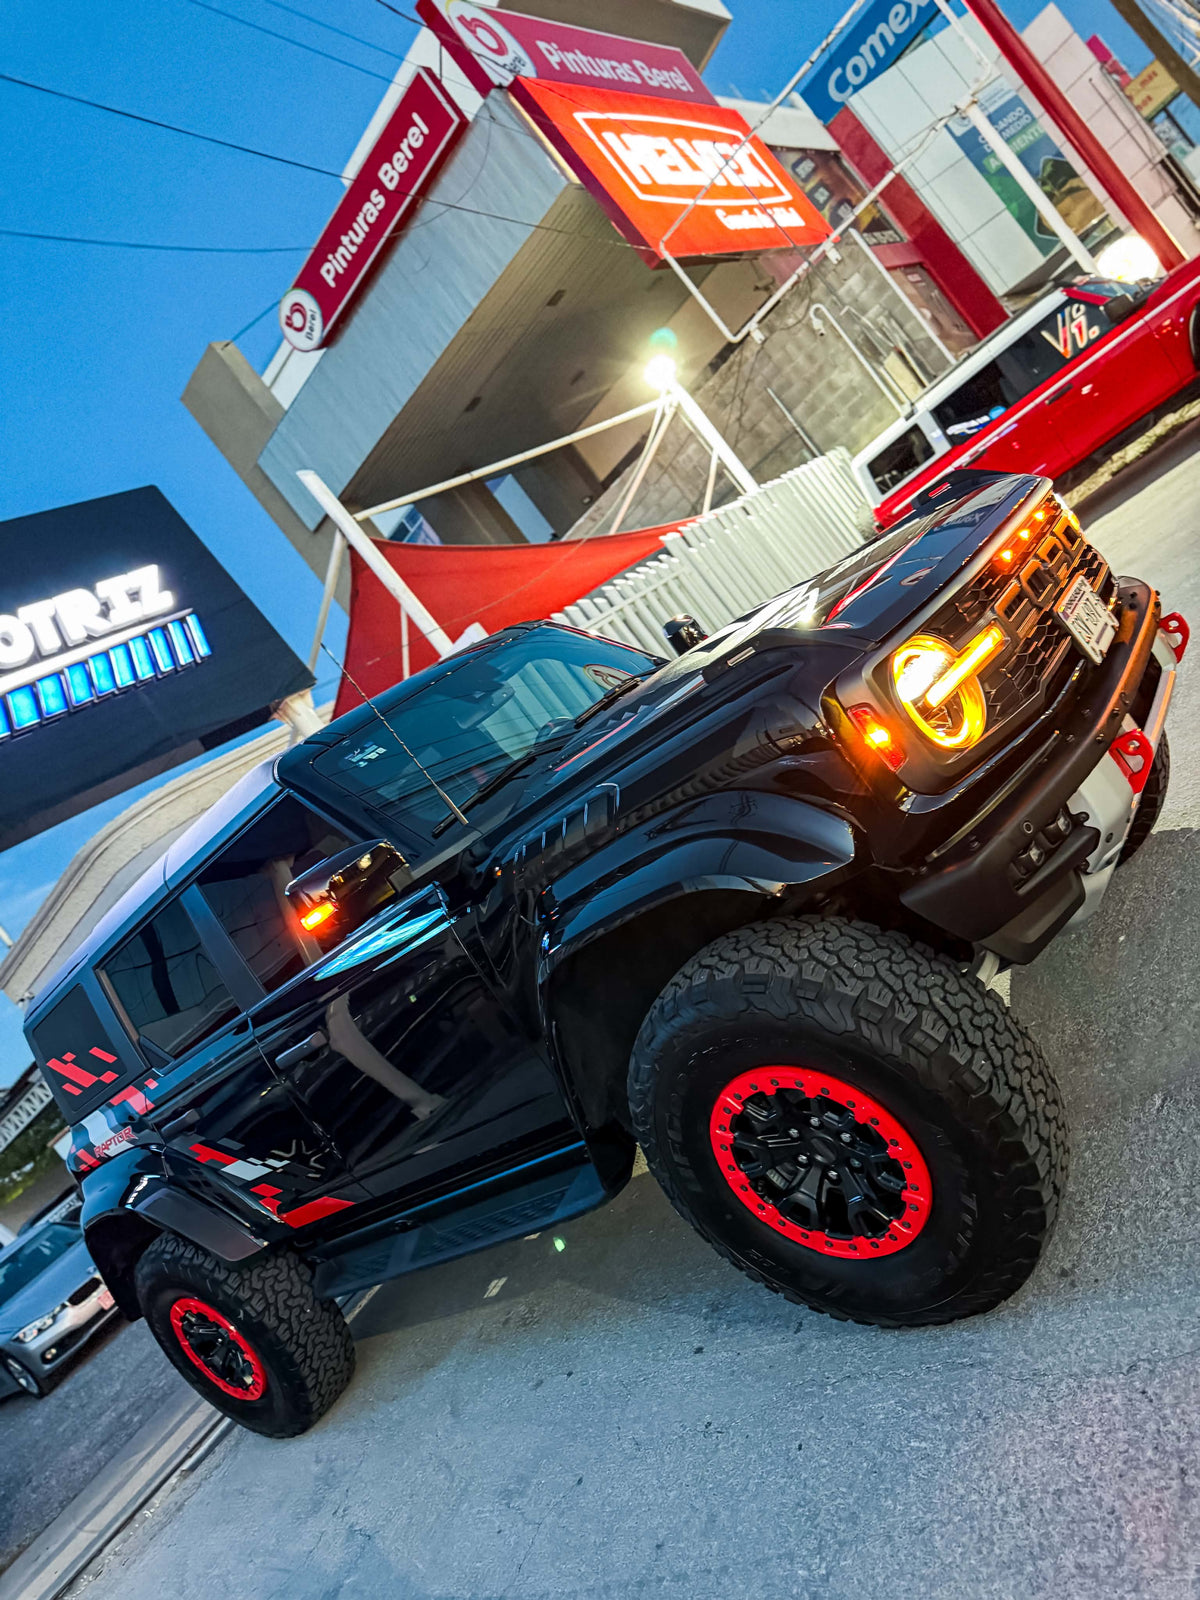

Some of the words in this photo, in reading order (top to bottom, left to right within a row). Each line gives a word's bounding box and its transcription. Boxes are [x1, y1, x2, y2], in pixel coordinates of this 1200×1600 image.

[534, 40, 641, 86] Pinturas
[633, 58, 695, 93] Berel
[320, 186, 386, 288] Pinturas
[378, 113, 430, 190] Berel
[304, 308, 318, 342] Berel
[93, 1126, 139, 1158] RAPTOR
